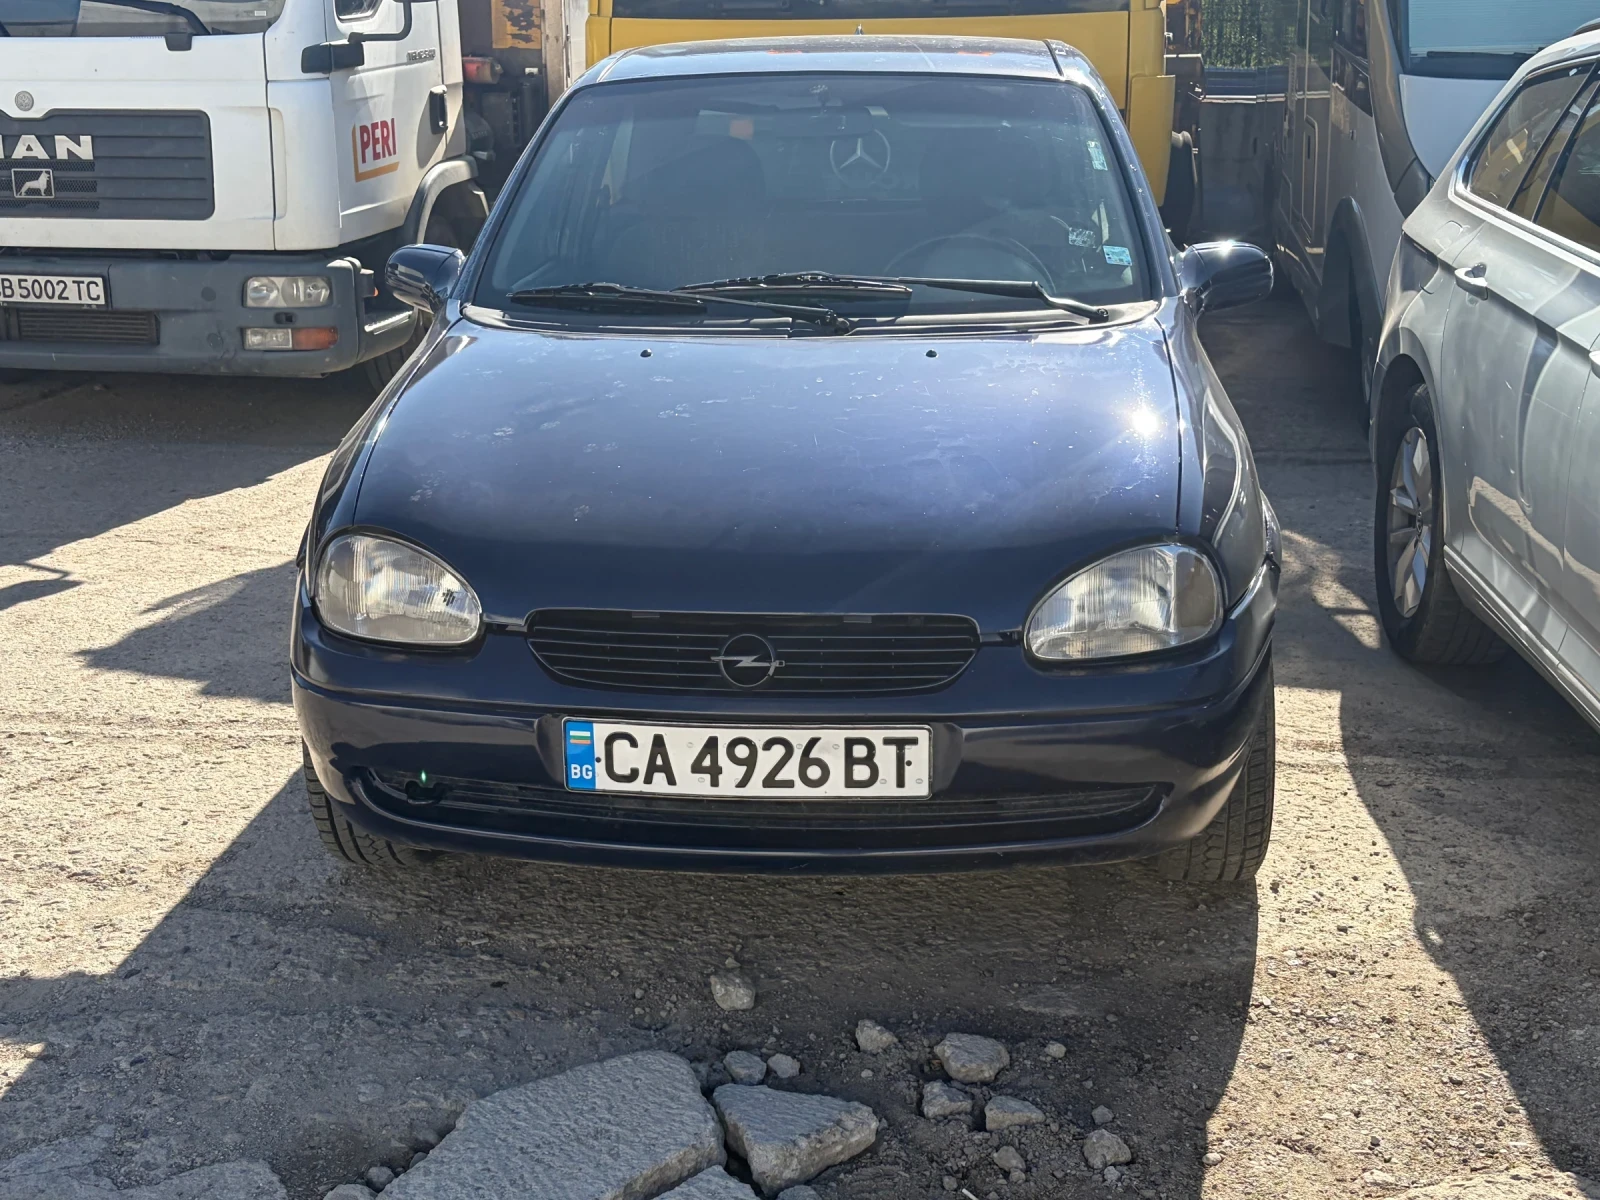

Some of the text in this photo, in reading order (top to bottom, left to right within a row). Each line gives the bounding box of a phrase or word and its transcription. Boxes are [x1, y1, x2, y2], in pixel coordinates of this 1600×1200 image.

[0, 134, 94, 160] AN
[359, 118, 397, 164] PERI
[0, 277, 101, 302] B 5002 TC
[570, 763, 593, 780] BG
[603, 731, 919, 789] CA 4926 BT
